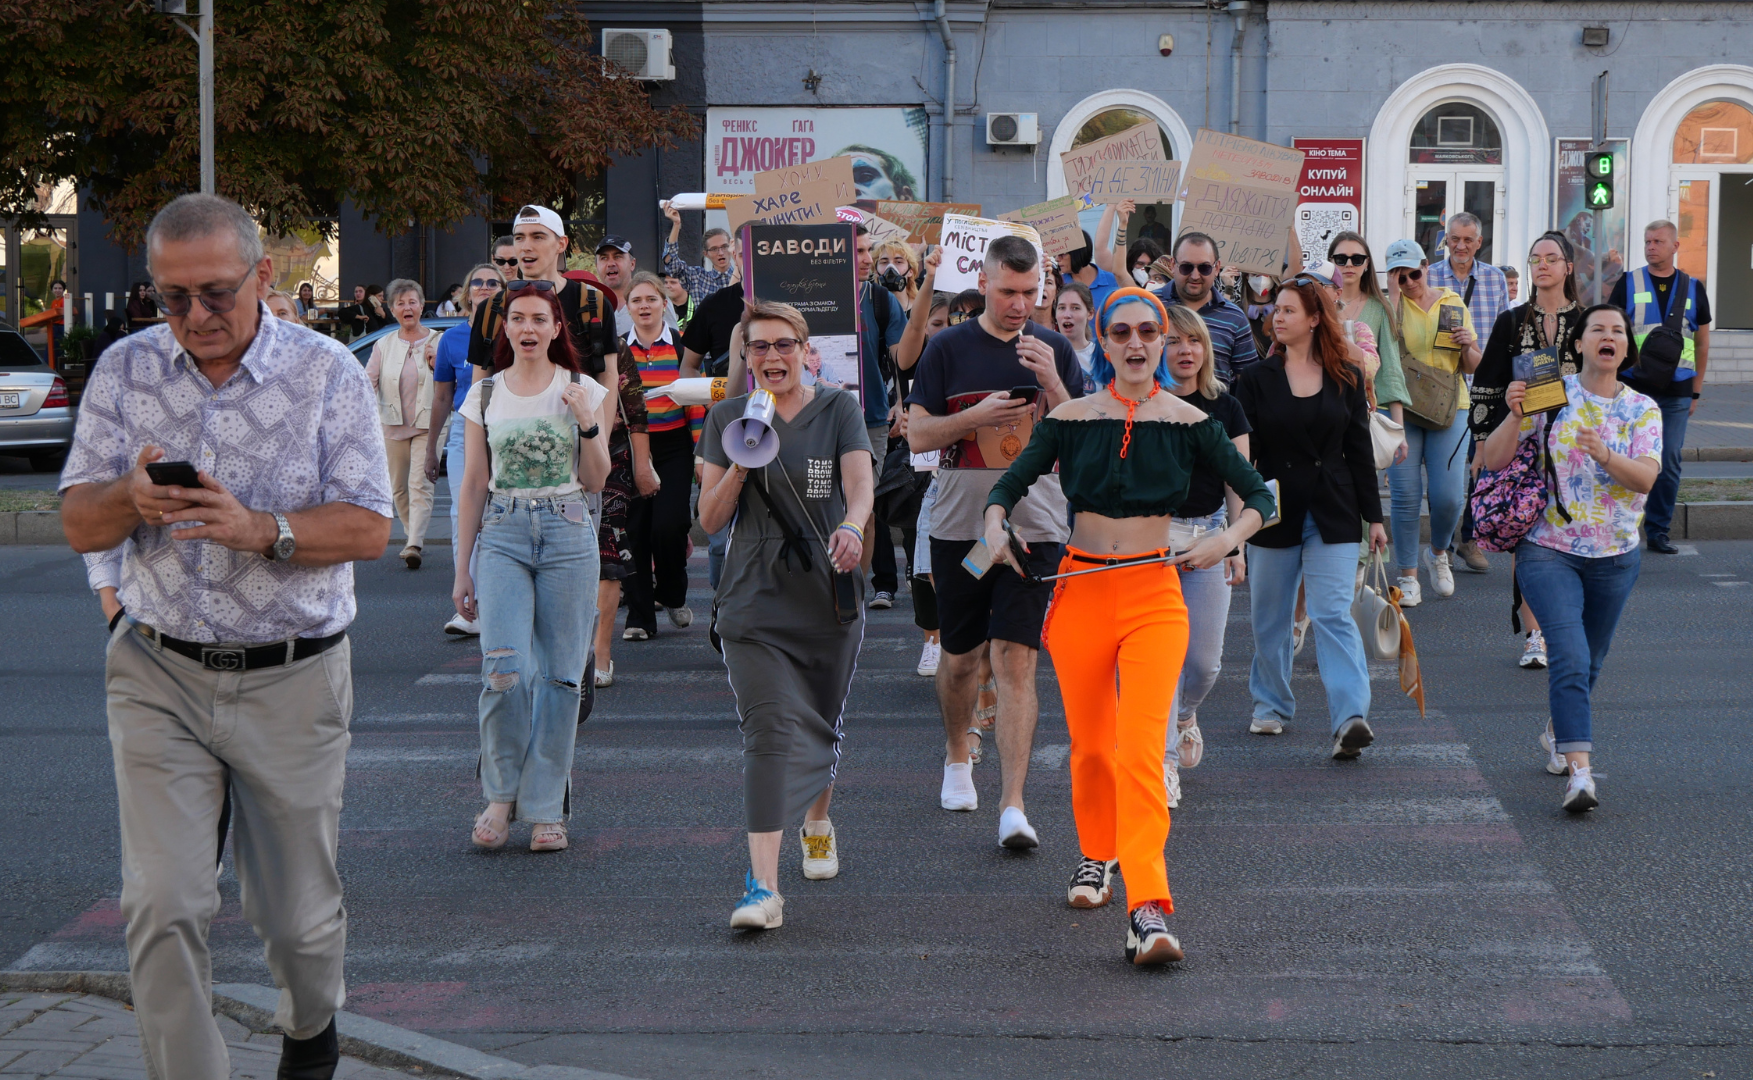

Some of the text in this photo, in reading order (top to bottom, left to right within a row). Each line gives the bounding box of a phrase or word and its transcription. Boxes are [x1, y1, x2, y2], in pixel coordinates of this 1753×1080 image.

[722, 119, 758, 133] ФЕНІКС
[1199, 130, 1259, 154] ПОТРІБНО
[717, 136, 816, 177] ДЖОКЕР
[1308, 149, 1347, 157] КІНО ТЕМА
[1308, 167, 1347, 180] КУПУЙ
[1090, 167, 1106, 195] А
[1109, 167, 1135, 194] ДЕ
[1300, 184, 1354, 197] ОНЛАЙН
[836, 210, 861, 223] STOP
[1200, 211, 1276, 239] ПОТРІБНО
[757, 238, 846, 257] ЗАВОДИ
[944, 231, 990, 253] МІСТ
[4, 395, 17, 404] BC
[713, 390, 726, 399] бе
[807, 458, 833, 469] TOMO
[807, 469, 833, 478] RROW
[807, 479, 832, 488] TOMO
[806, 489, 832, 498] RROW
